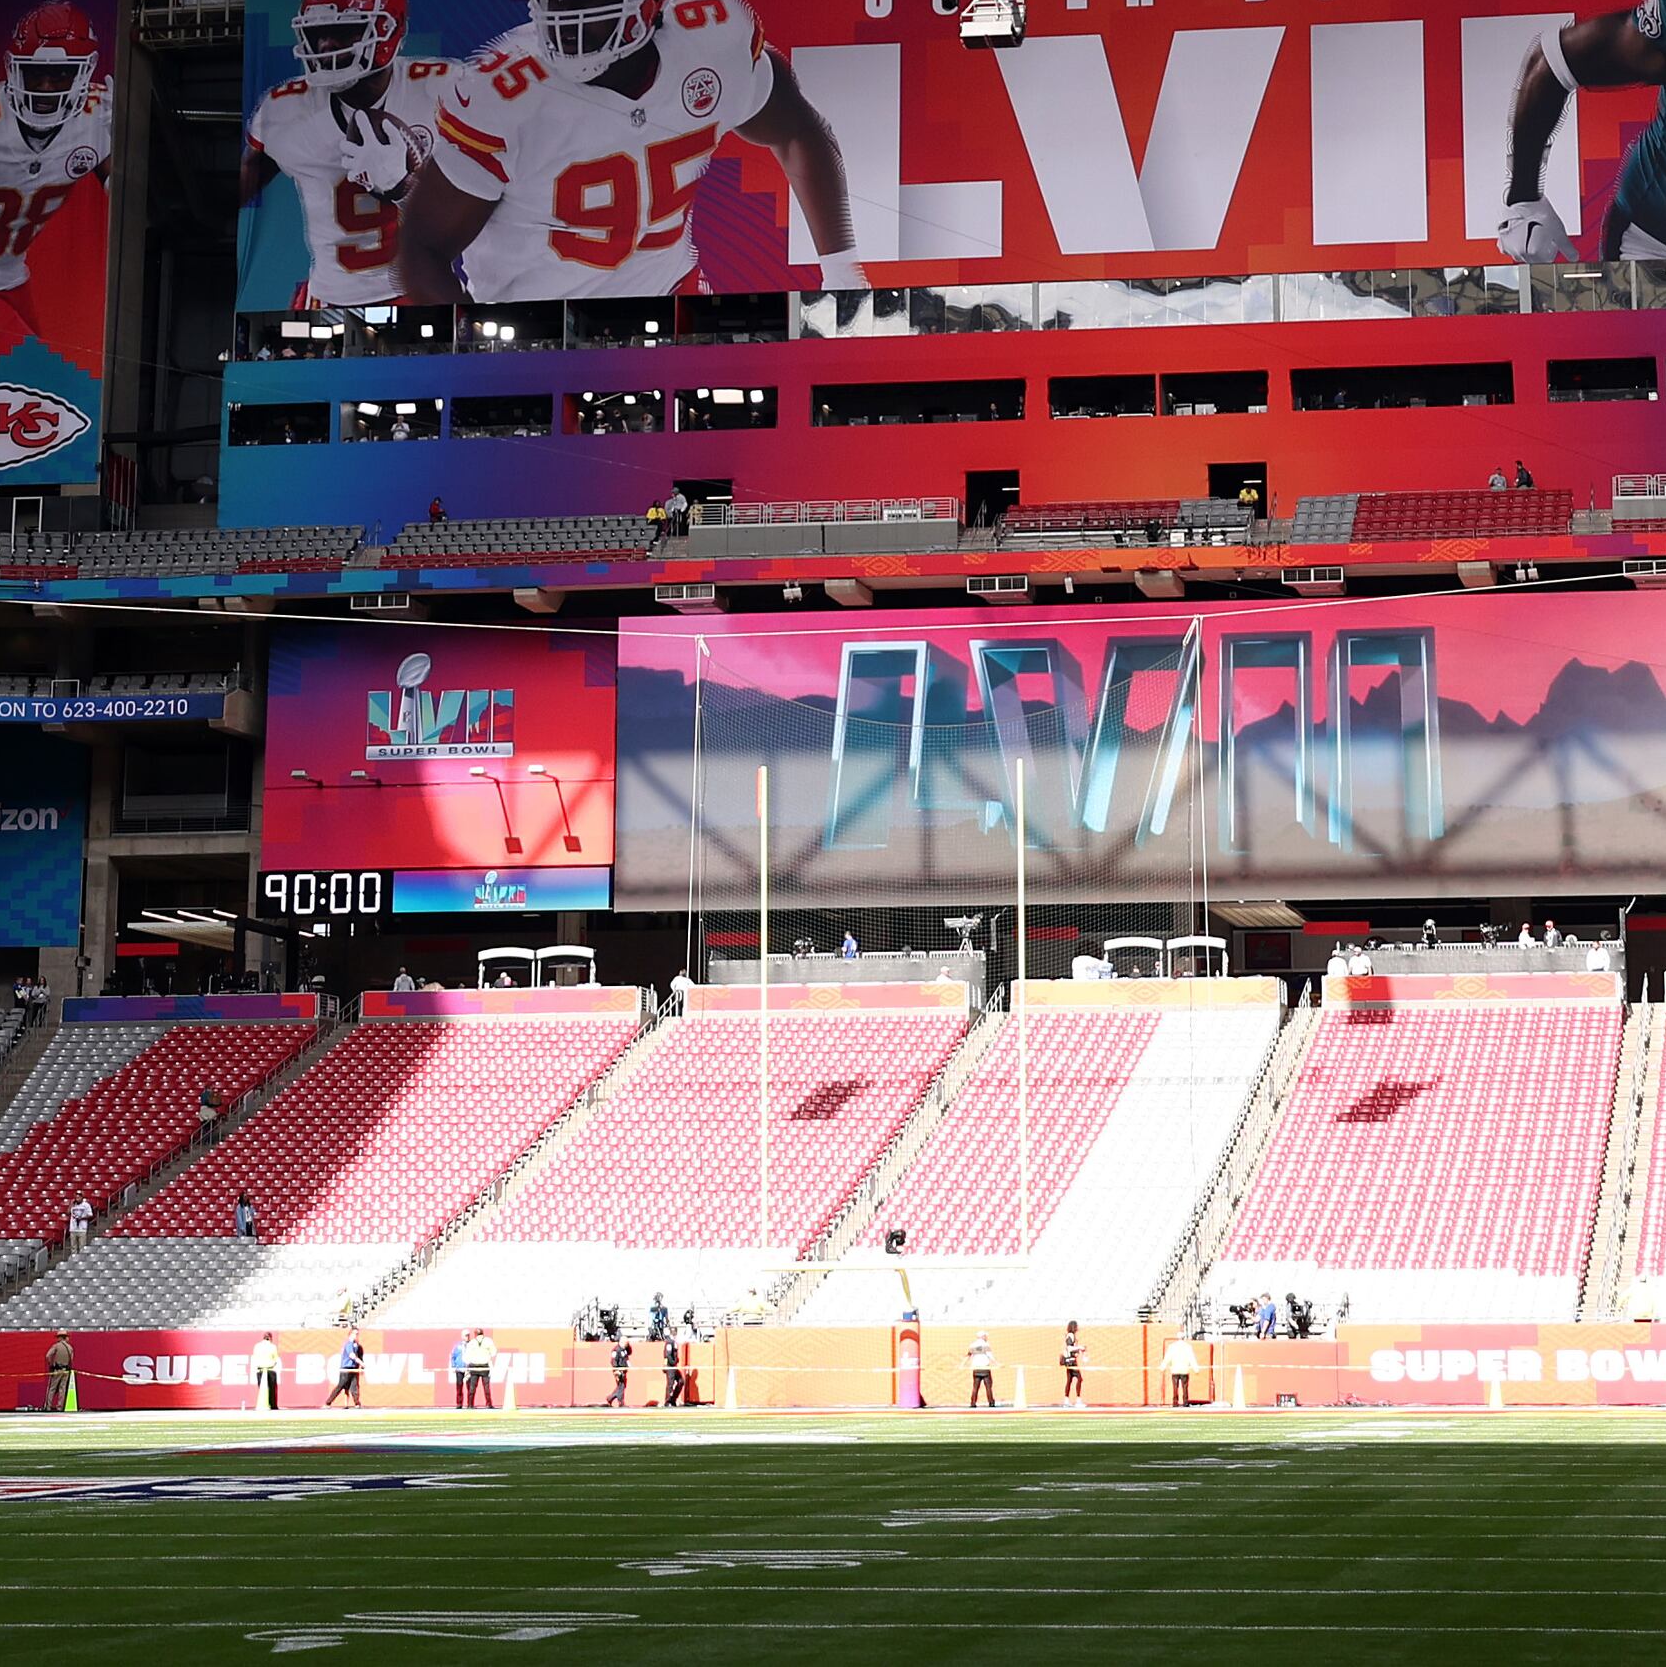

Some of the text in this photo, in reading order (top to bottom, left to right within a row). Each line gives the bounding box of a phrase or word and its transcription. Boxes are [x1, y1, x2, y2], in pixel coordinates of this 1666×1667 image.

[548, 121, 719, 270] 95
[32, 702, 57, 719] TO
[62, 699, 189, 718] 623-400-2210
[378, 745, 501, 757] SUPER BOWL
[265, 873, 381, 915] 90:00
[1370, 1350, 1542, 1381] SUPER
